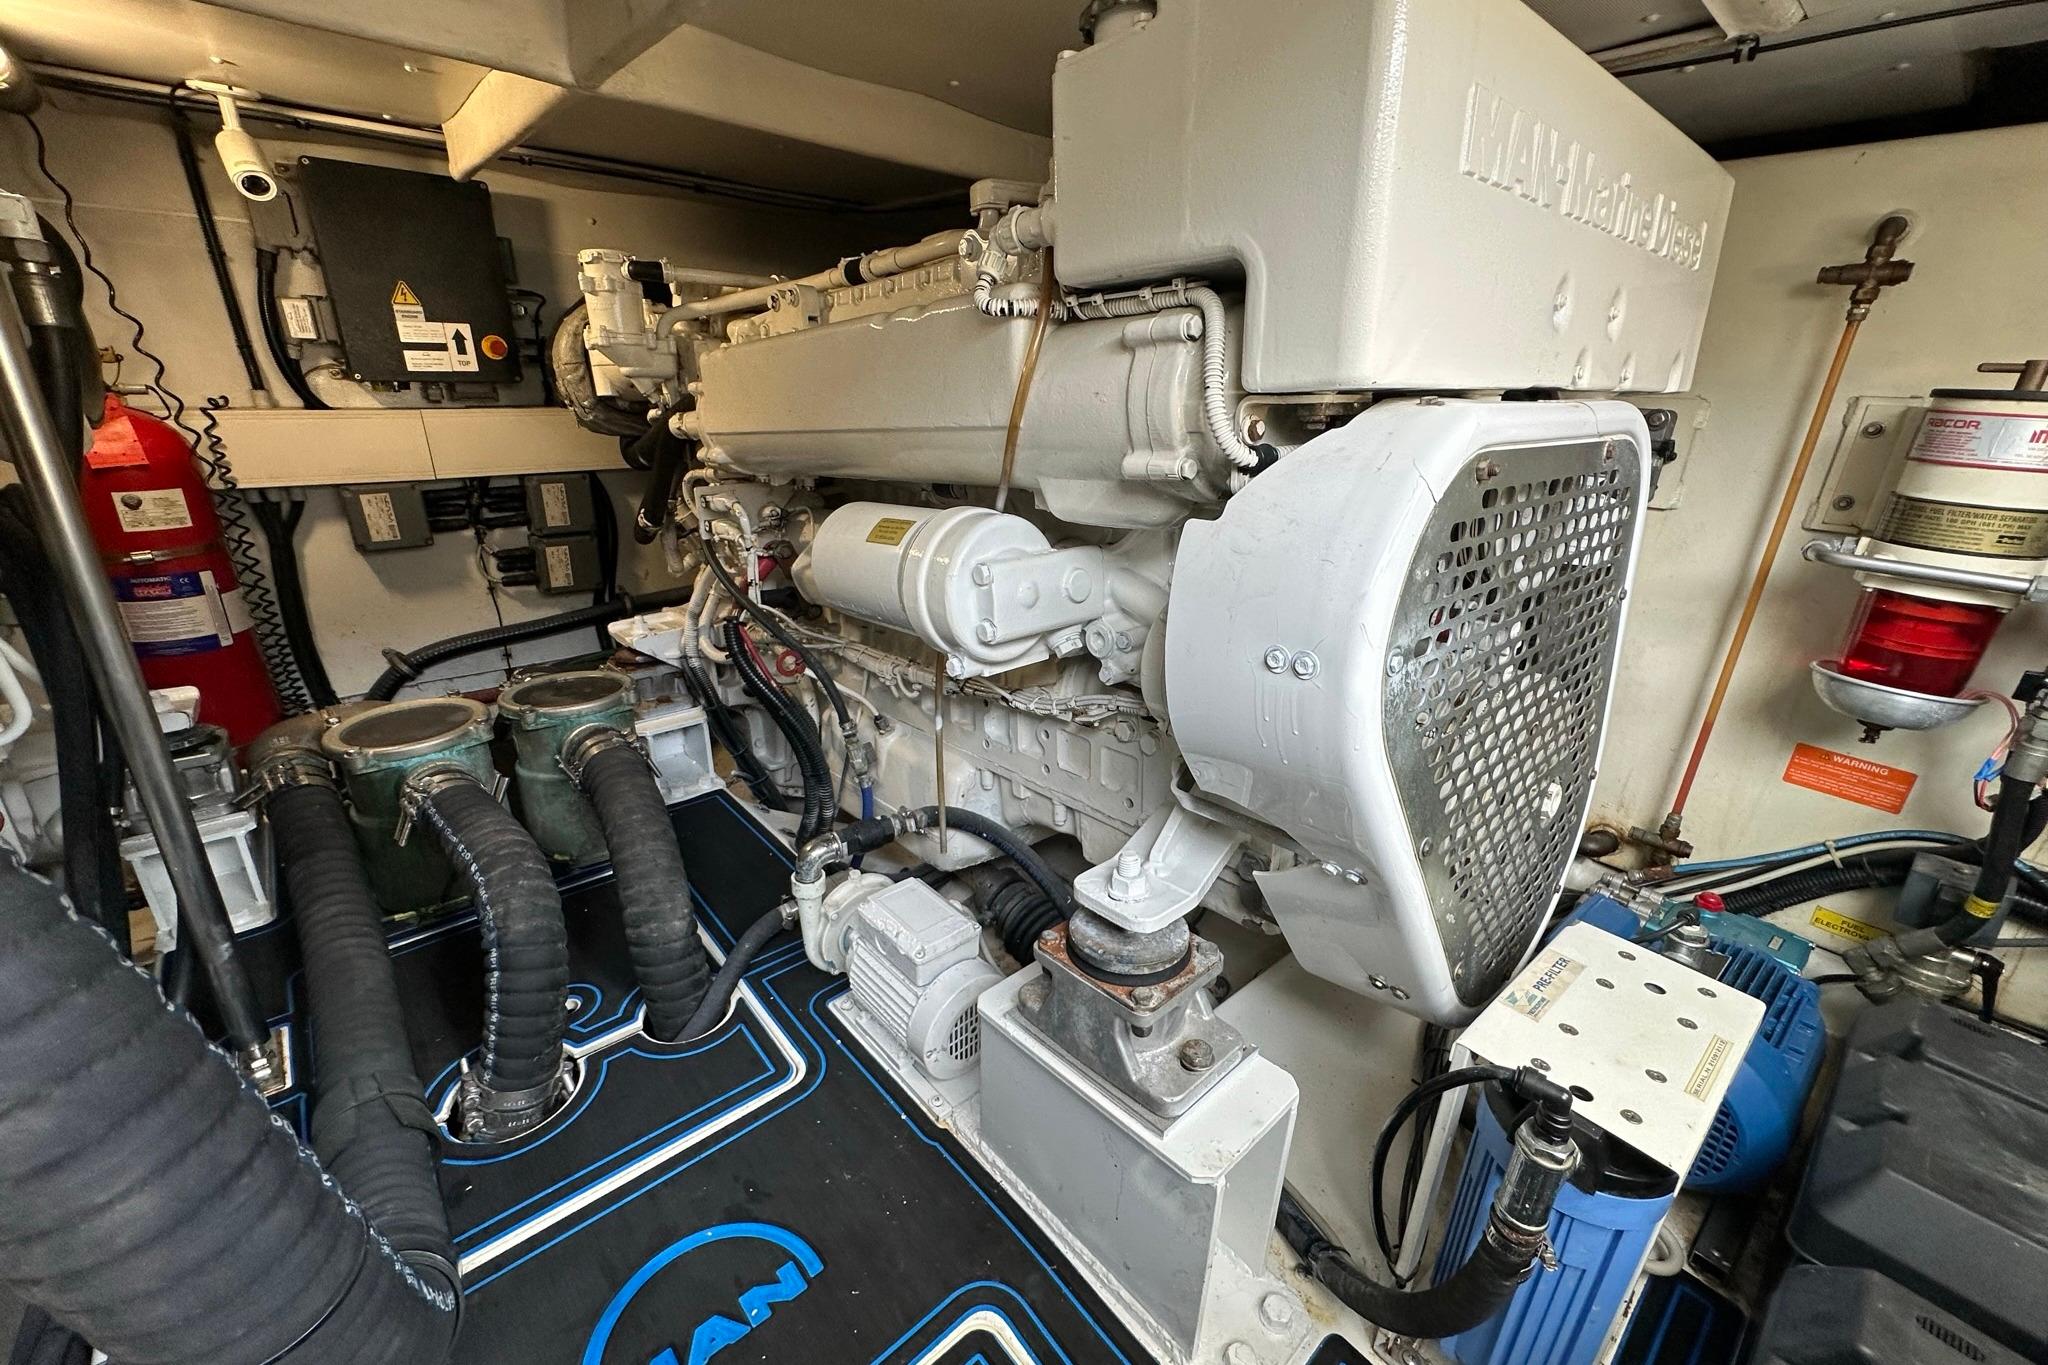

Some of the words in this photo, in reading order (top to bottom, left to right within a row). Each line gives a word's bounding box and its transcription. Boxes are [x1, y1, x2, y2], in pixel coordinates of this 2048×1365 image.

[1929, 506, 1945, 516] FUEL
[1946, 509, 1998, 521] FILTER/WATER
[129, 576, 172, 584] AUTOMATIC
[1832, 754, 1890, 777] WARNING
[1840, 919, 1865, 933] FUEL
[489, 947, 498, 968] MPI
[1533, 957, 1571, 993] PRE-FILTER
